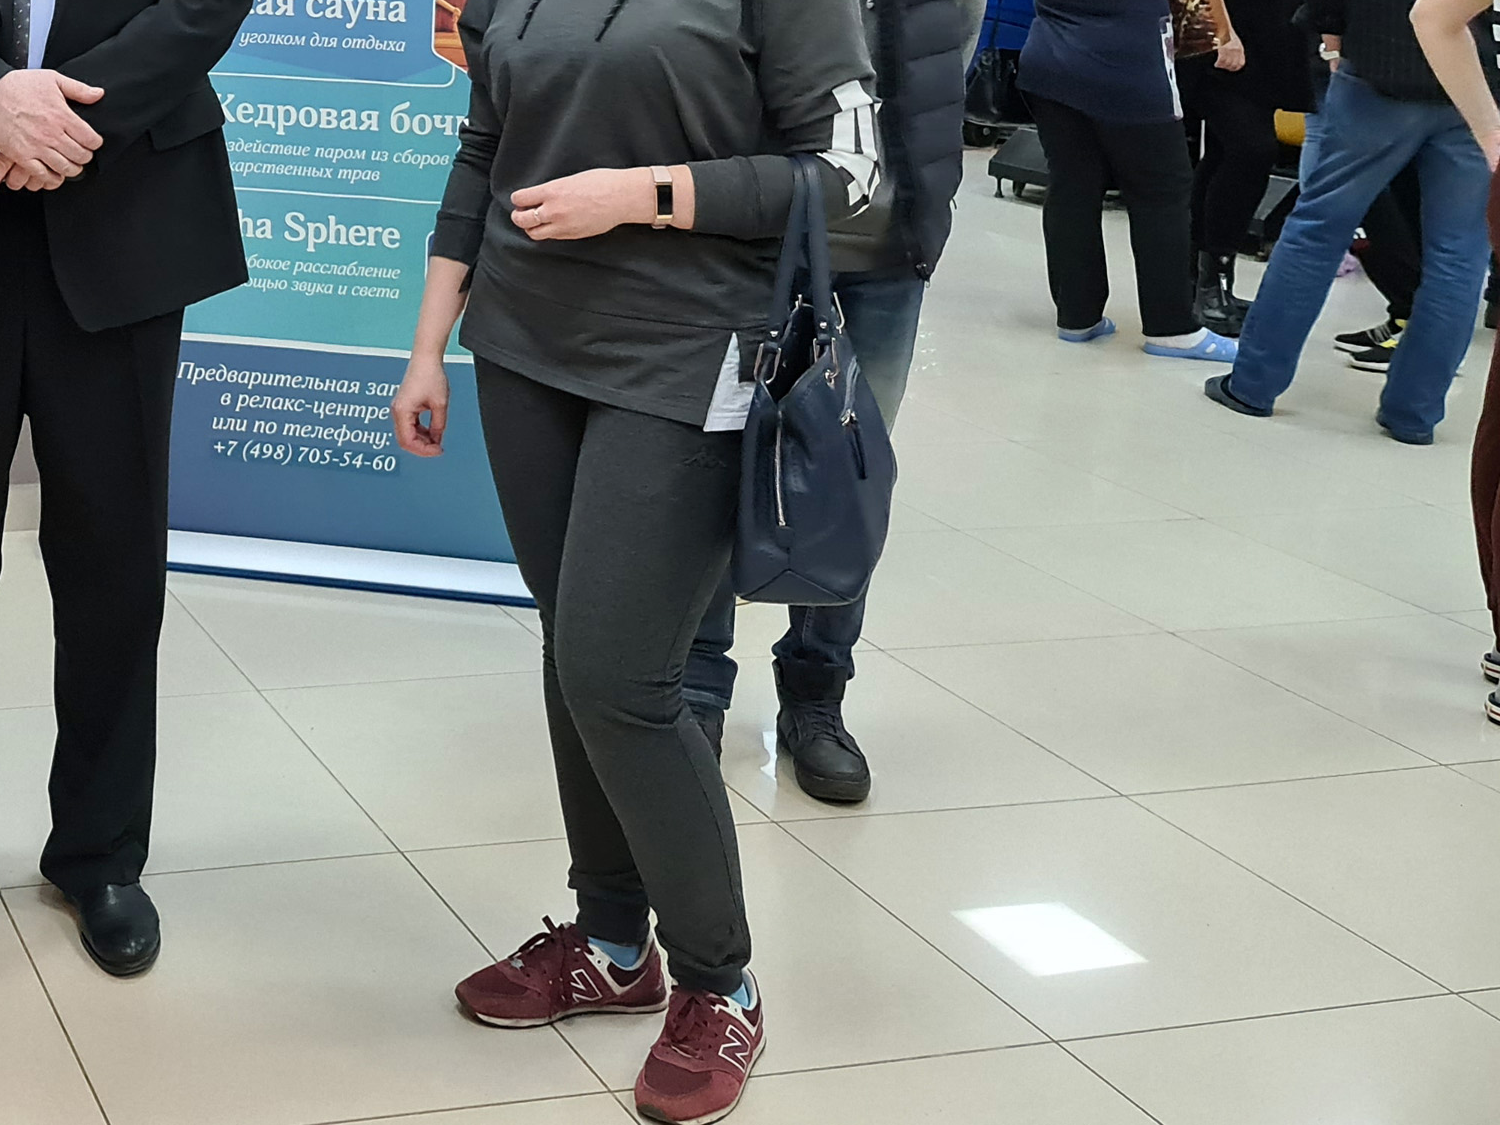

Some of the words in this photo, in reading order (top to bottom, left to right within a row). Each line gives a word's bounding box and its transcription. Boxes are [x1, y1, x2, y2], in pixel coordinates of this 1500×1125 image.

[239, 31, 306, 47] уголком
[309, 31, 338, 48] для
[341, 34, 406, 52] отдыха
[217, 93, 380, 136] Кедровая
[314, 146, 366, 163] паром
[371, 150, 389, 162] из
[393, 148, 450, 169] сборов
[337, 168, 381, 184] трав
[284, 212, 401, 252] Sphere
[247, 254, 291, 271] бокое
[293, 261, 401, 280] расслабление
[291, 281, 334, 296] звука
[338, 285, 348, 296] и
[351, 286, 400, 300] света
[177, 361, 360, 394] Предварительная
[220, 392, 232, 406] в
[235, 393, 390, 424] релакс-центре
[212, 416, 248, 432] или
[253, 420, 277, 435] по
[282, 422, 393, 450] телефону:
[213, 440, 238, 456] +7
[242, 439, 292, 466] (498)
[298, 446, 396, 472] 705-54-60
